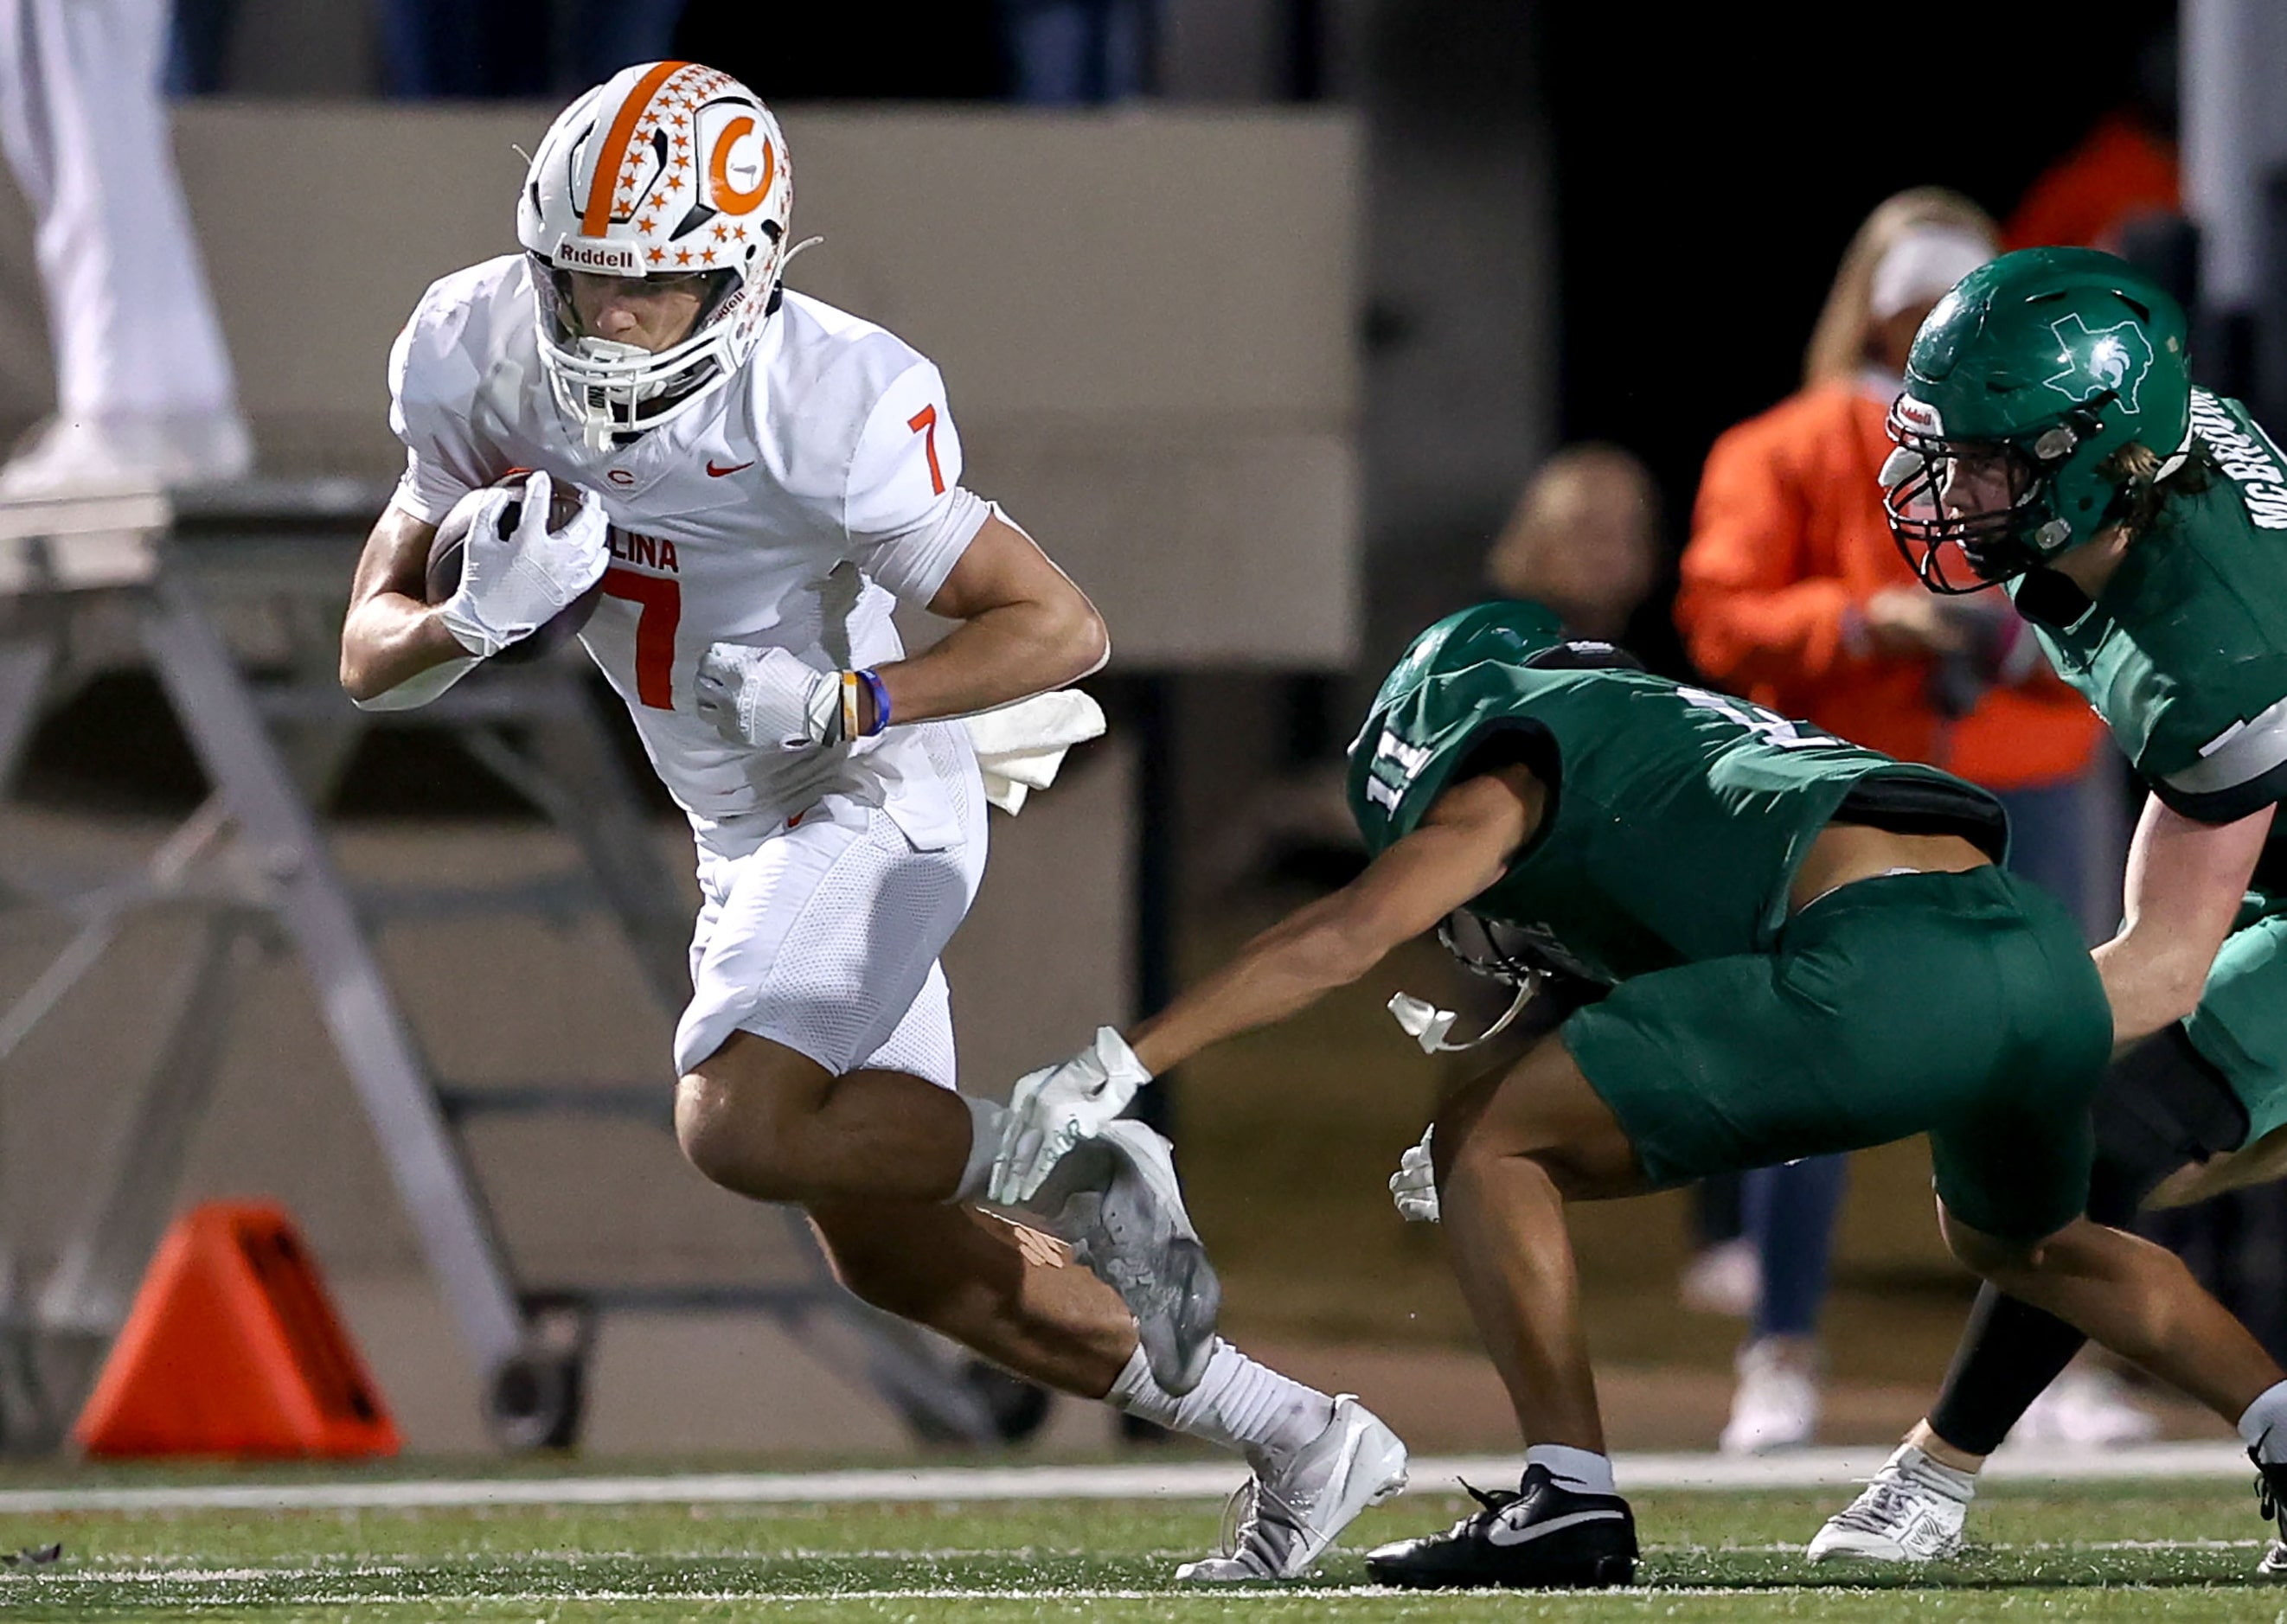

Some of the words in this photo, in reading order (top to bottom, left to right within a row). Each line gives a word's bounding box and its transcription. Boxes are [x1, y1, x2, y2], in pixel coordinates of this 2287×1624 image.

[709, 116, 774, 216] C
[561, 243, 633, 268] Riddell
[607, 470, 634, 484] C
[906, 403, 946, 496] 7
[603, 567, 681, 711] 7
[1367, 731, 1433, 822] 11
